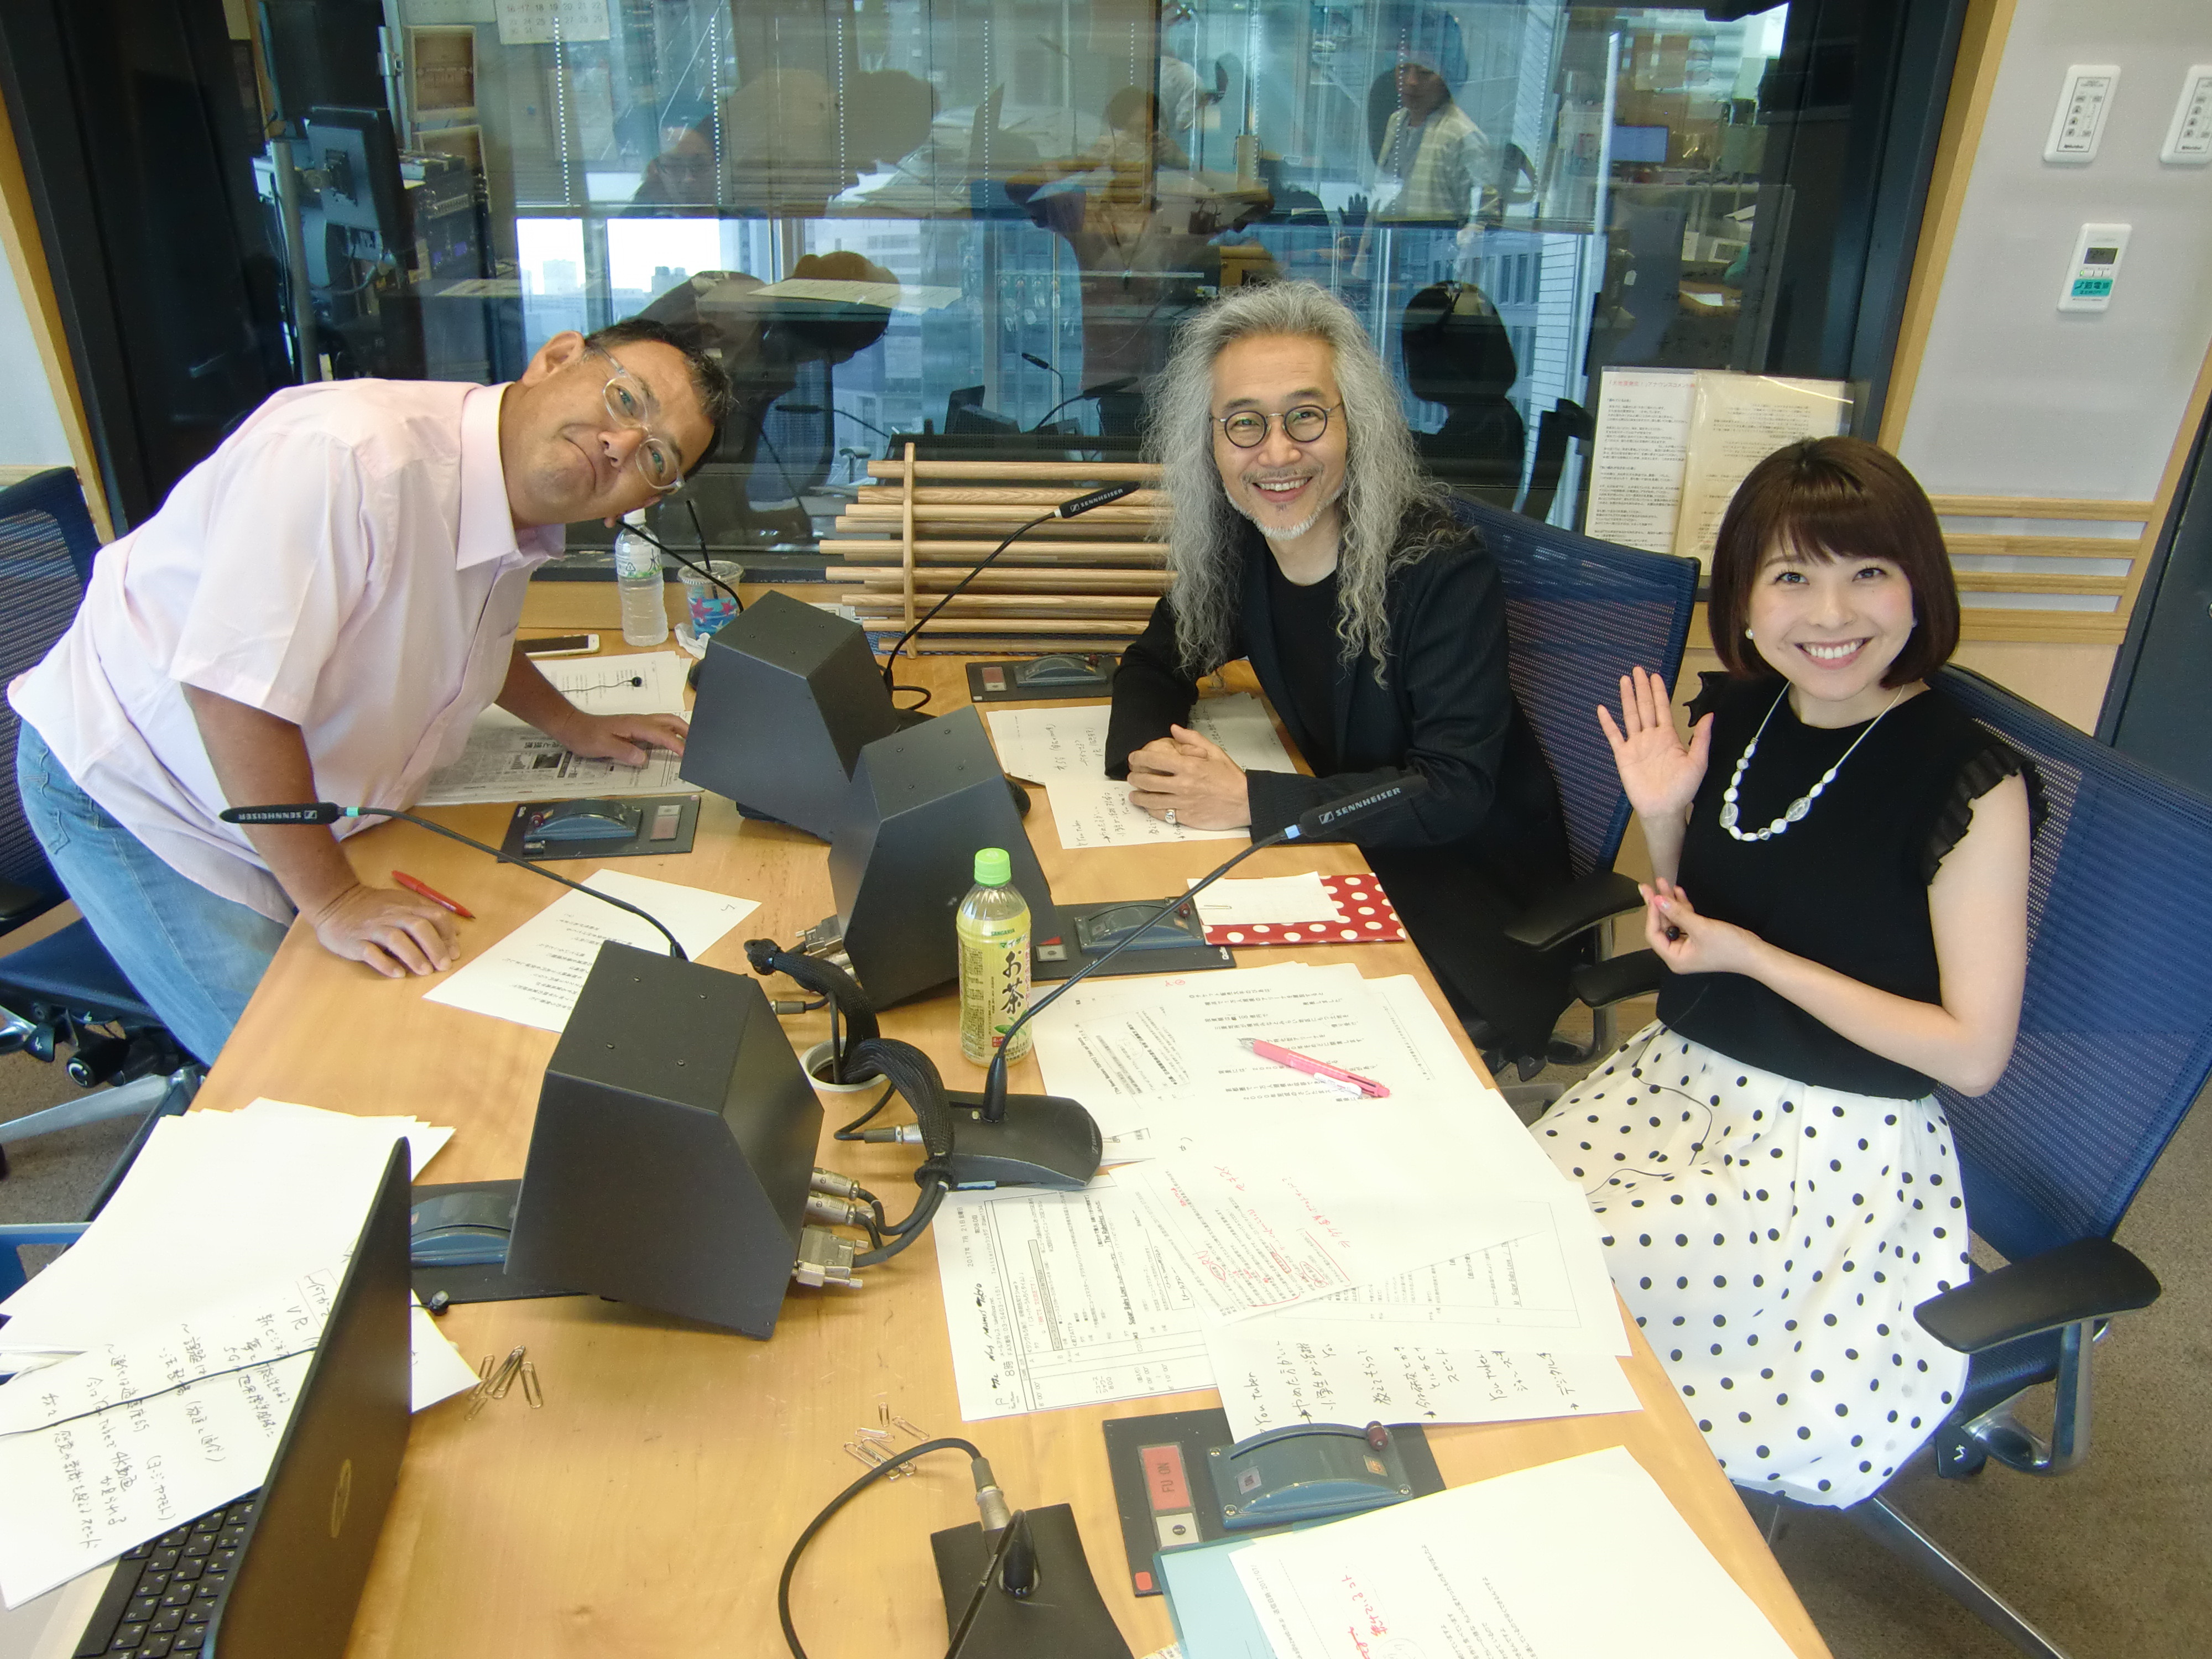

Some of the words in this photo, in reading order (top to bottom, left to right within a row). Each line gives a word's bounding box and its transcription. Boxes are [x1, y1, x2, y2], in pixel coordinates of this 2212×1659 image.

[1079, 487, 1124, 508] SENNHEISER
[1335, 786, 1402, 817] SENNHEISER
[238, 812, 302, 821] SENNHEISER
[1003, 1360, 1015, 1377] 8時
[1105, 1375, 1115, 1390] 800
